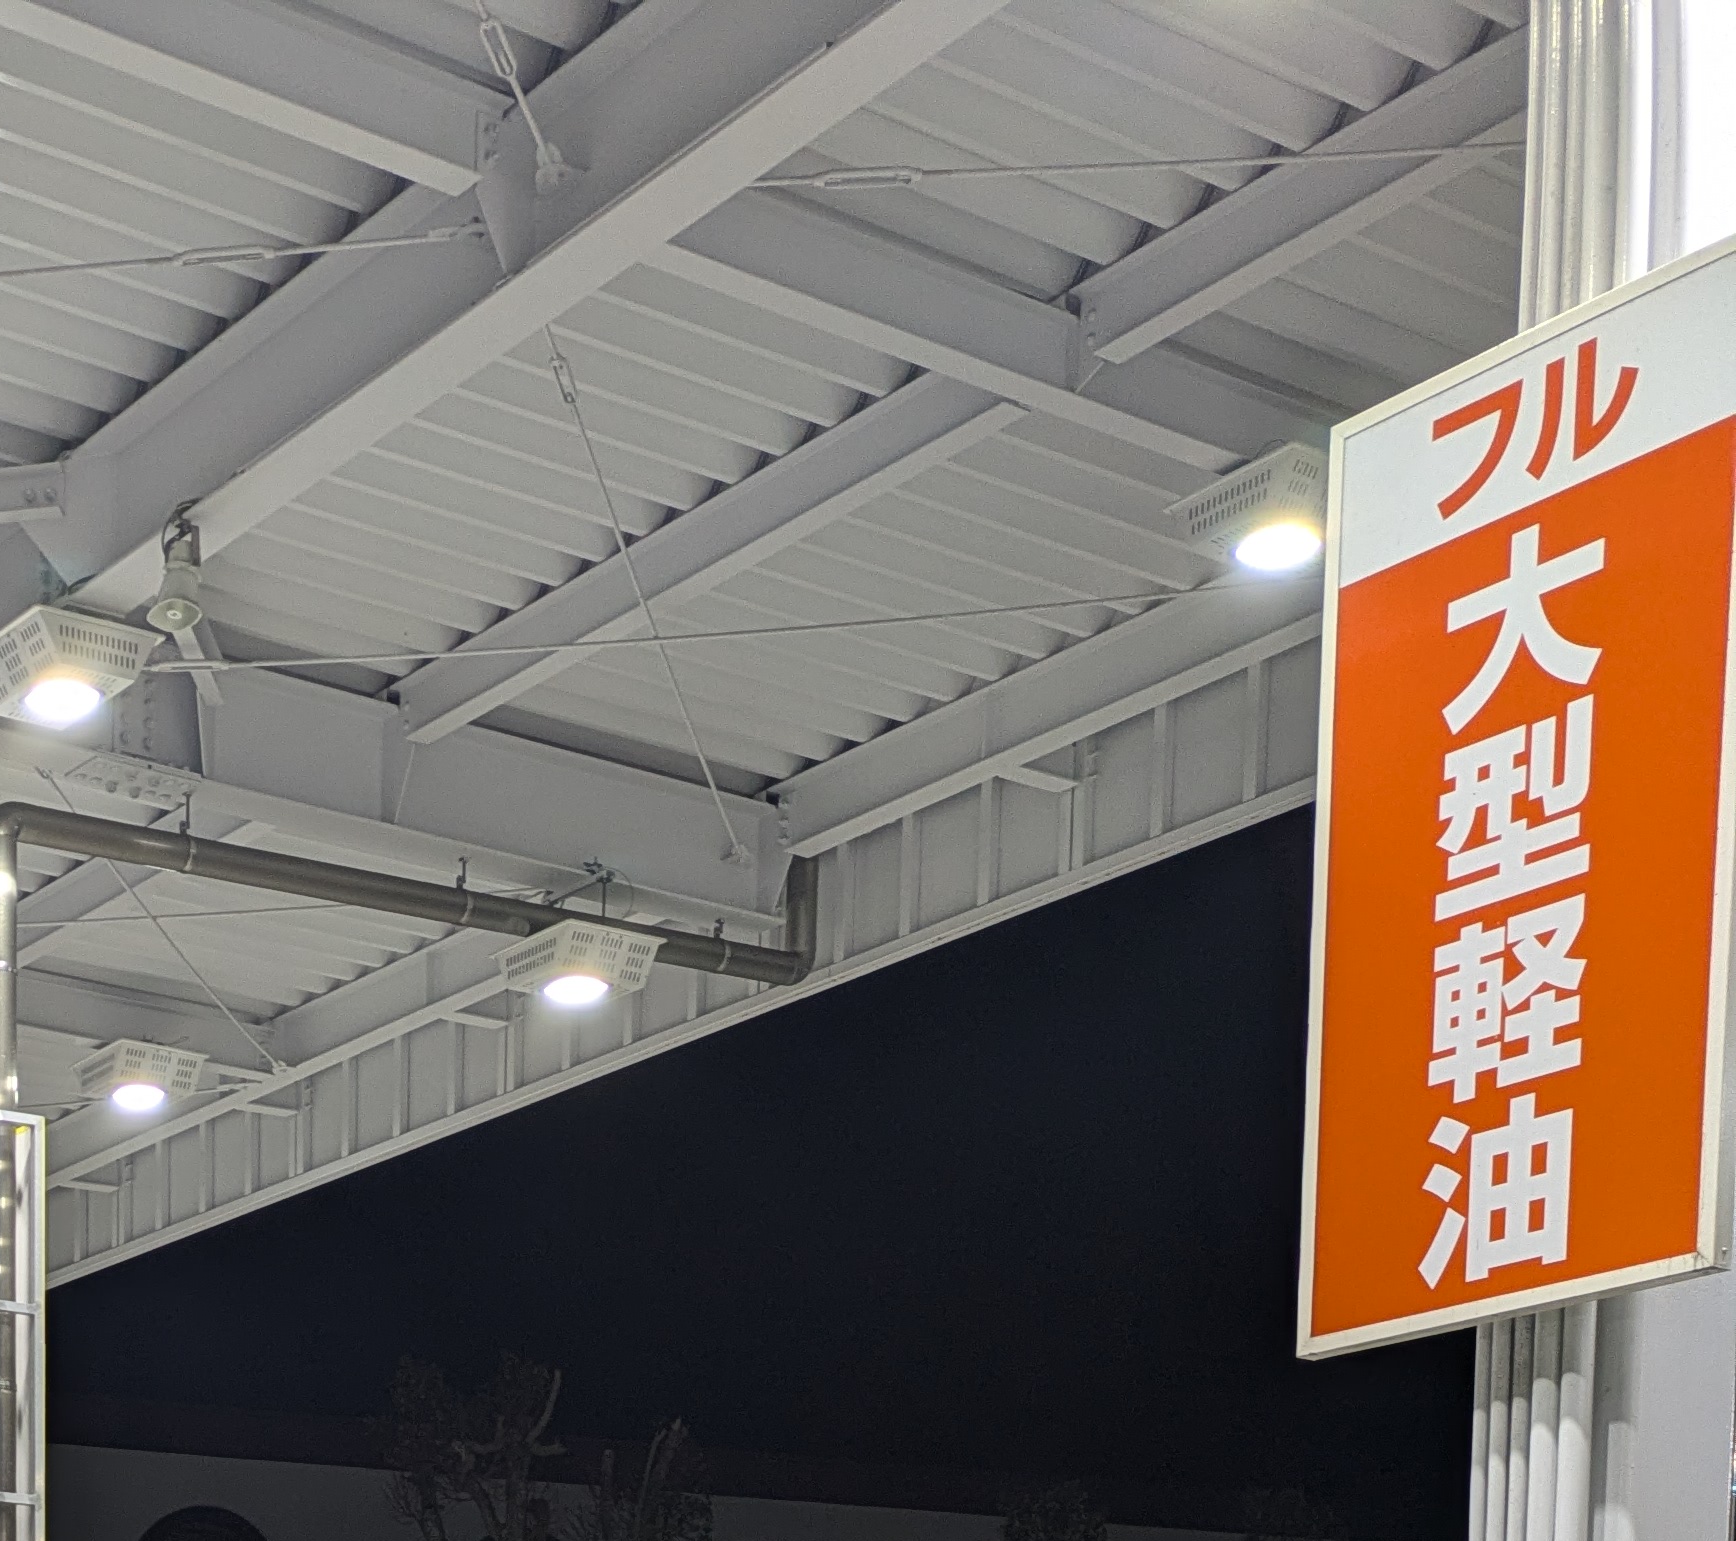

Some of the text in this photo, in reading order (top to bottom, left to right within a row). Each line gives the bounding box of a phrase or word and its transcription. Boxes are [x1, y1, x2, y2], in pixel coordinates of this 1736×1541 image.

[1431, 336, 1639, 522] フル
[1417, 524, 1606, 1291] 大型軽油
